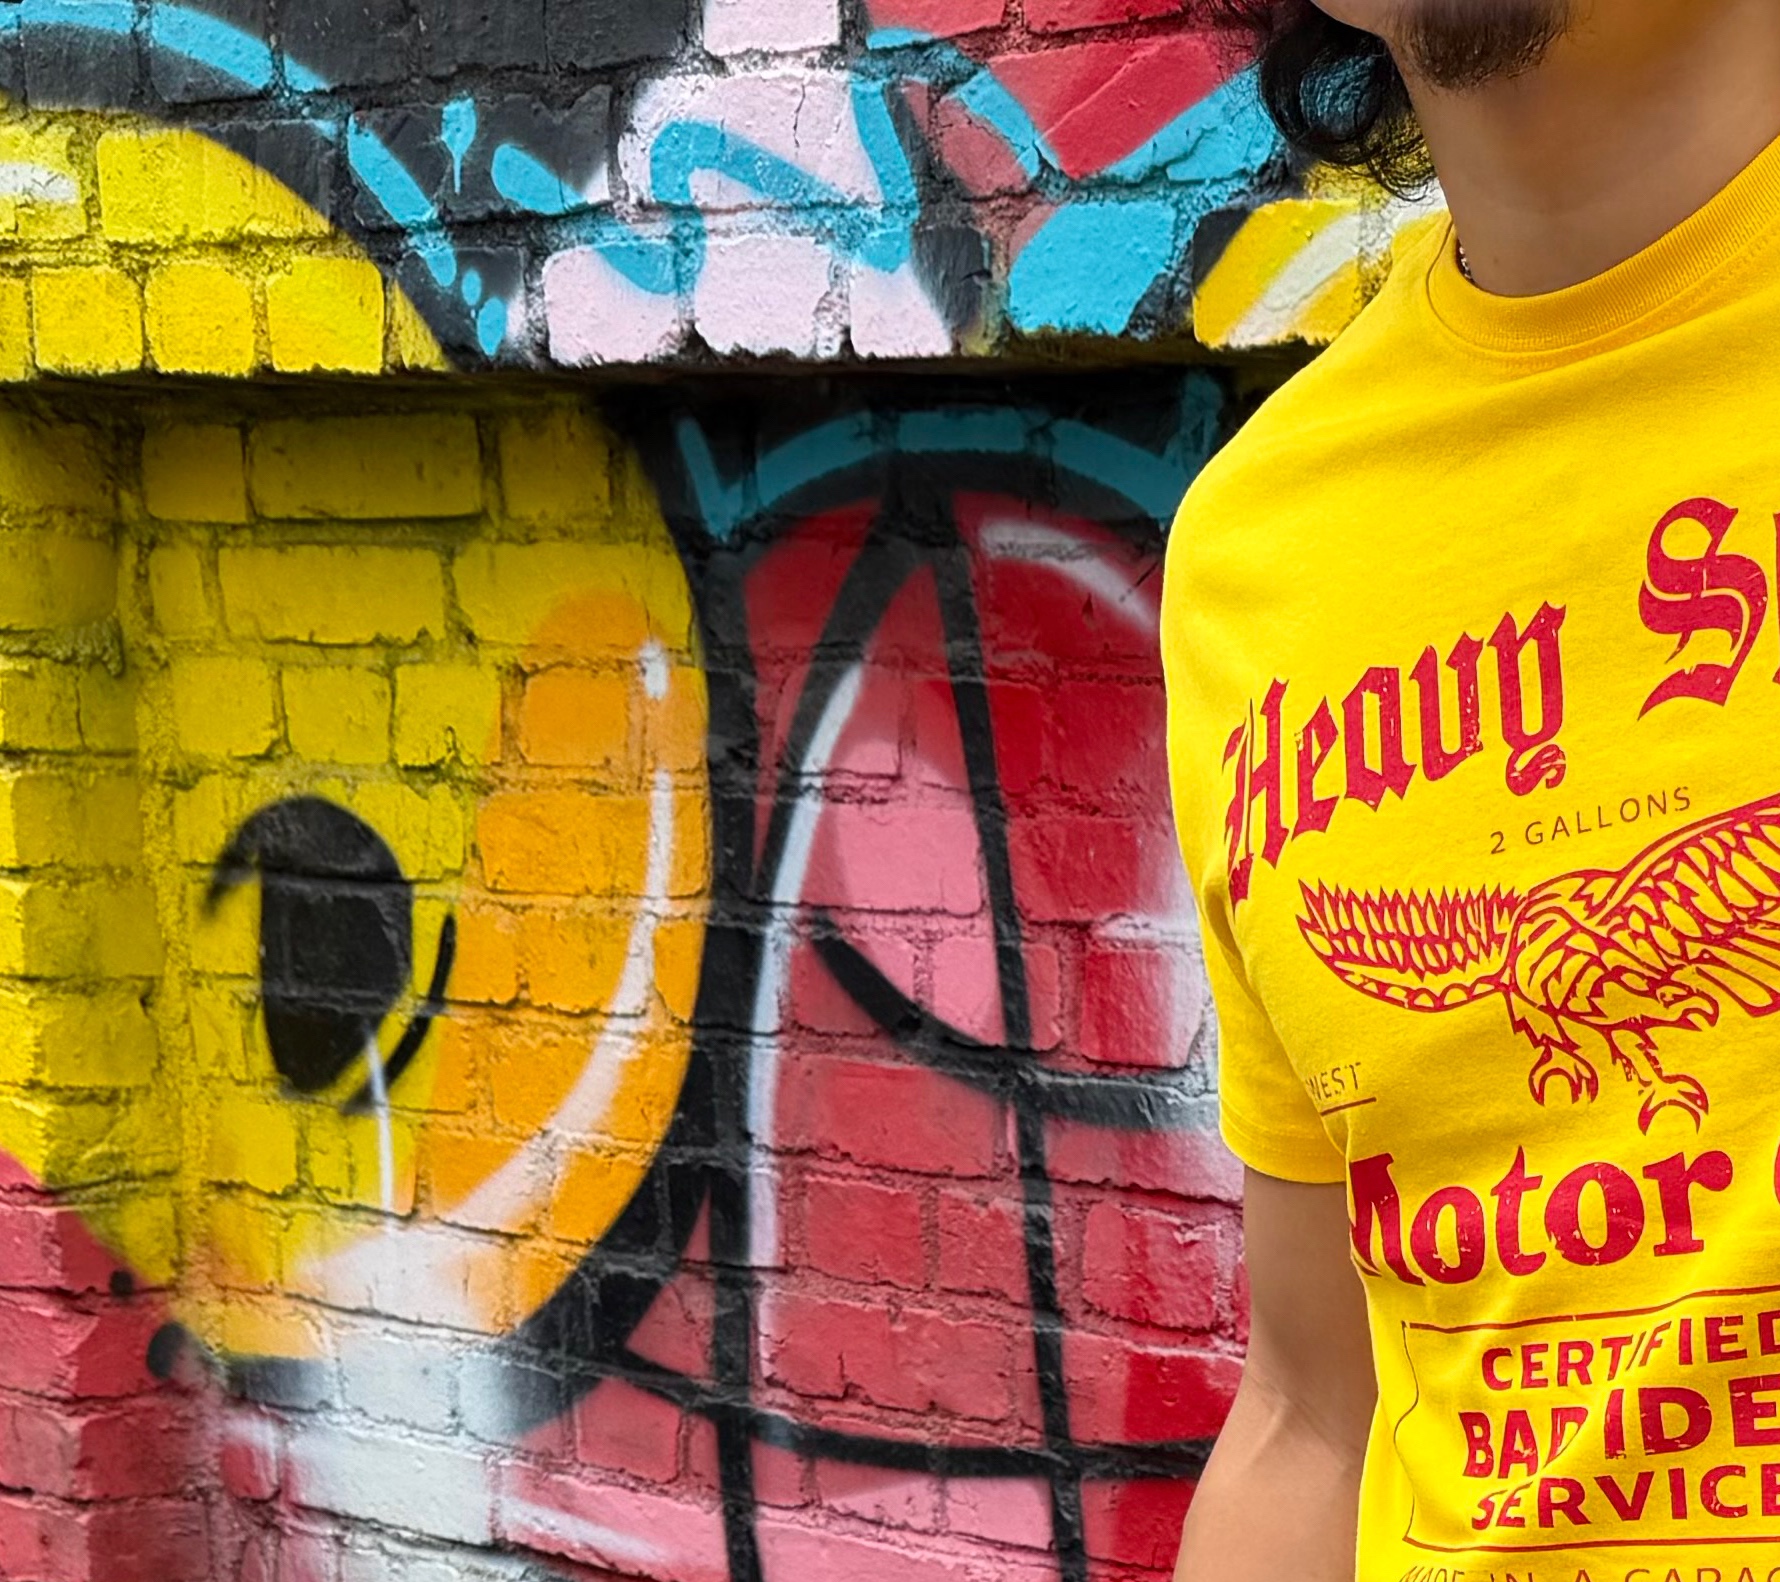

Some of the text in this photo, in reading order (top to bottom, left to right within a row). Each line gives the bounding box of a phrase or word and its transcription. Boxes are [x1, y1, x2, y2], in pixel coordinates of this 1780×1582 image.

[1222, 600, 1568, 923] Heavy
[1490, 786, 1691, 854] 2 GALLONS
[1458, 1406, 1589, 1479] BAD
